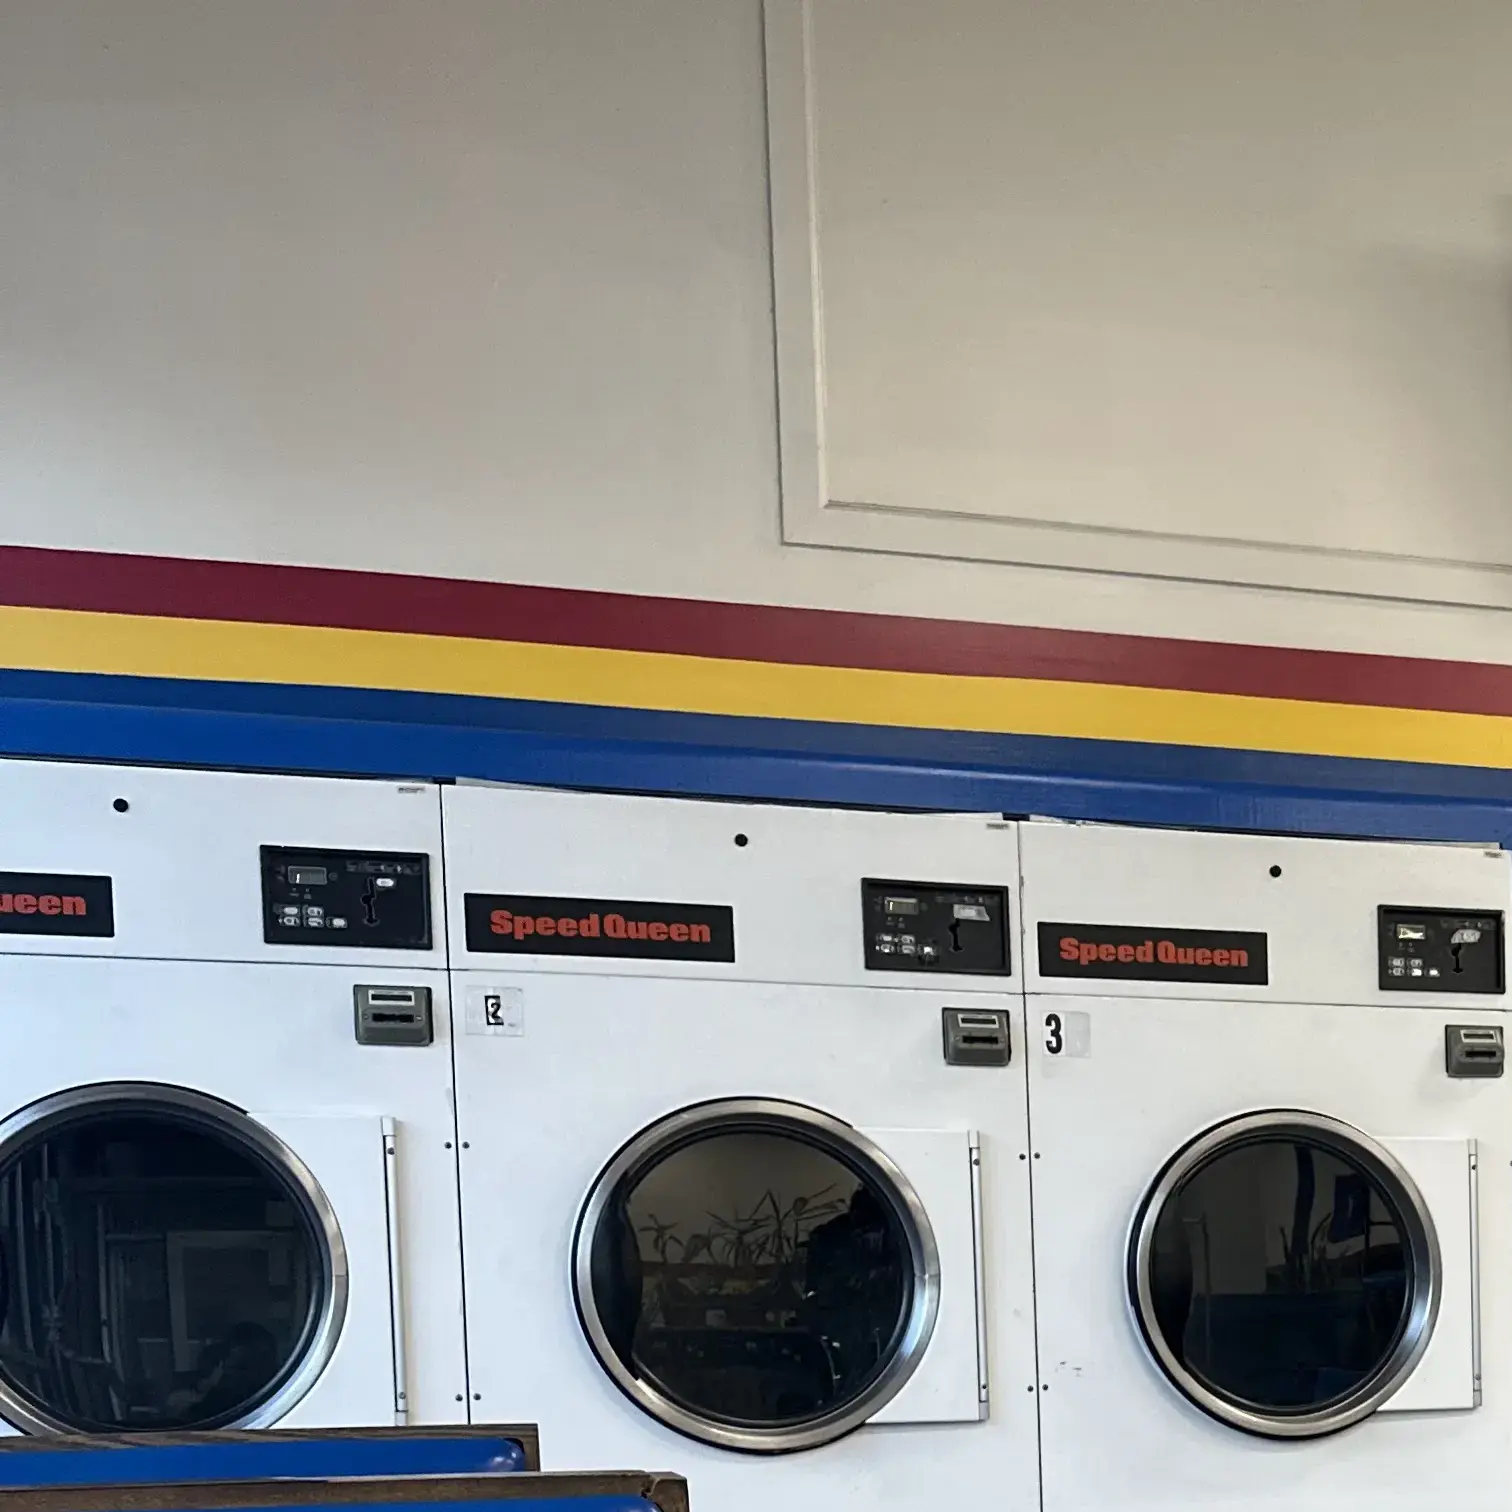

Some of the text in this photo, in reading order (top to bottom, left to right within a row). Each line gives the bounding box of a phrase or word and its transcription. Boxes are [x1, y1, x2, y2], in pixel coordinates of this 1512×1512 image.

[0, 893, 87, 916] ueen
[490, 909, 711, 942] Speed Queen
[1059, 937, 1249, 967] Speed Queen
[490, 1002, 502, 1019] 2
[1045, 1013, 1063, 1055] 3
